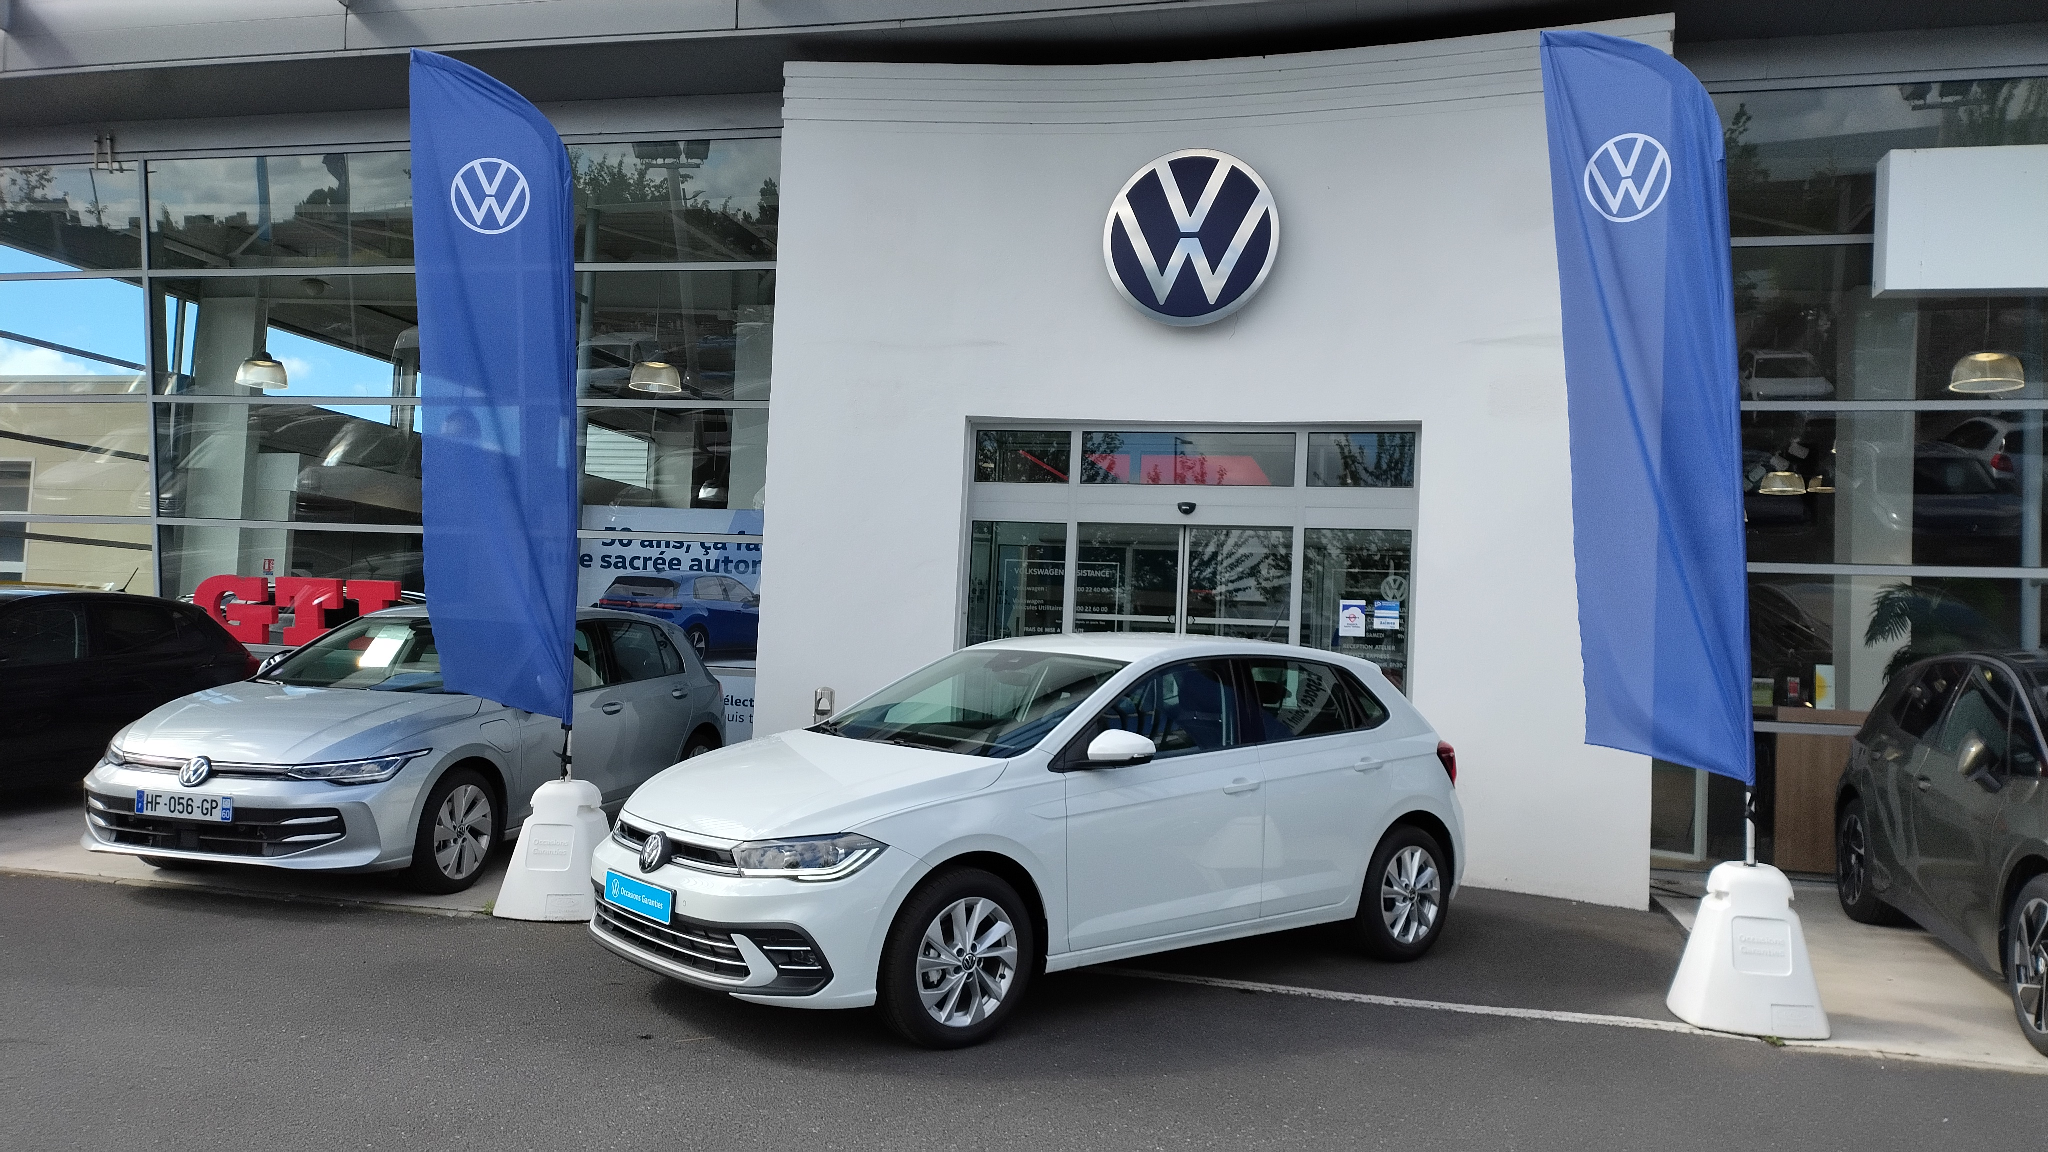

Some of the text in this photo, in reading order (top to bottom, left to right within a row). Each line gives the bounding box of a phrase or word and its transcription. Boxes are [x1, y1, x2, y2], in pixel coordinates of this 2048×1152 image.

[1584, 132, 1672, 223] VW
[451, 157, 531, 235] VW
[1103, 148, 1279, 326] VW
[600, 551, 682, 572] sacrée
[725, 711, 744, 723] uis
[221, 810, 230, 819] 60
[620, 886, 642, 902] Occasions
[641, 894, 664, 910] Garanties
